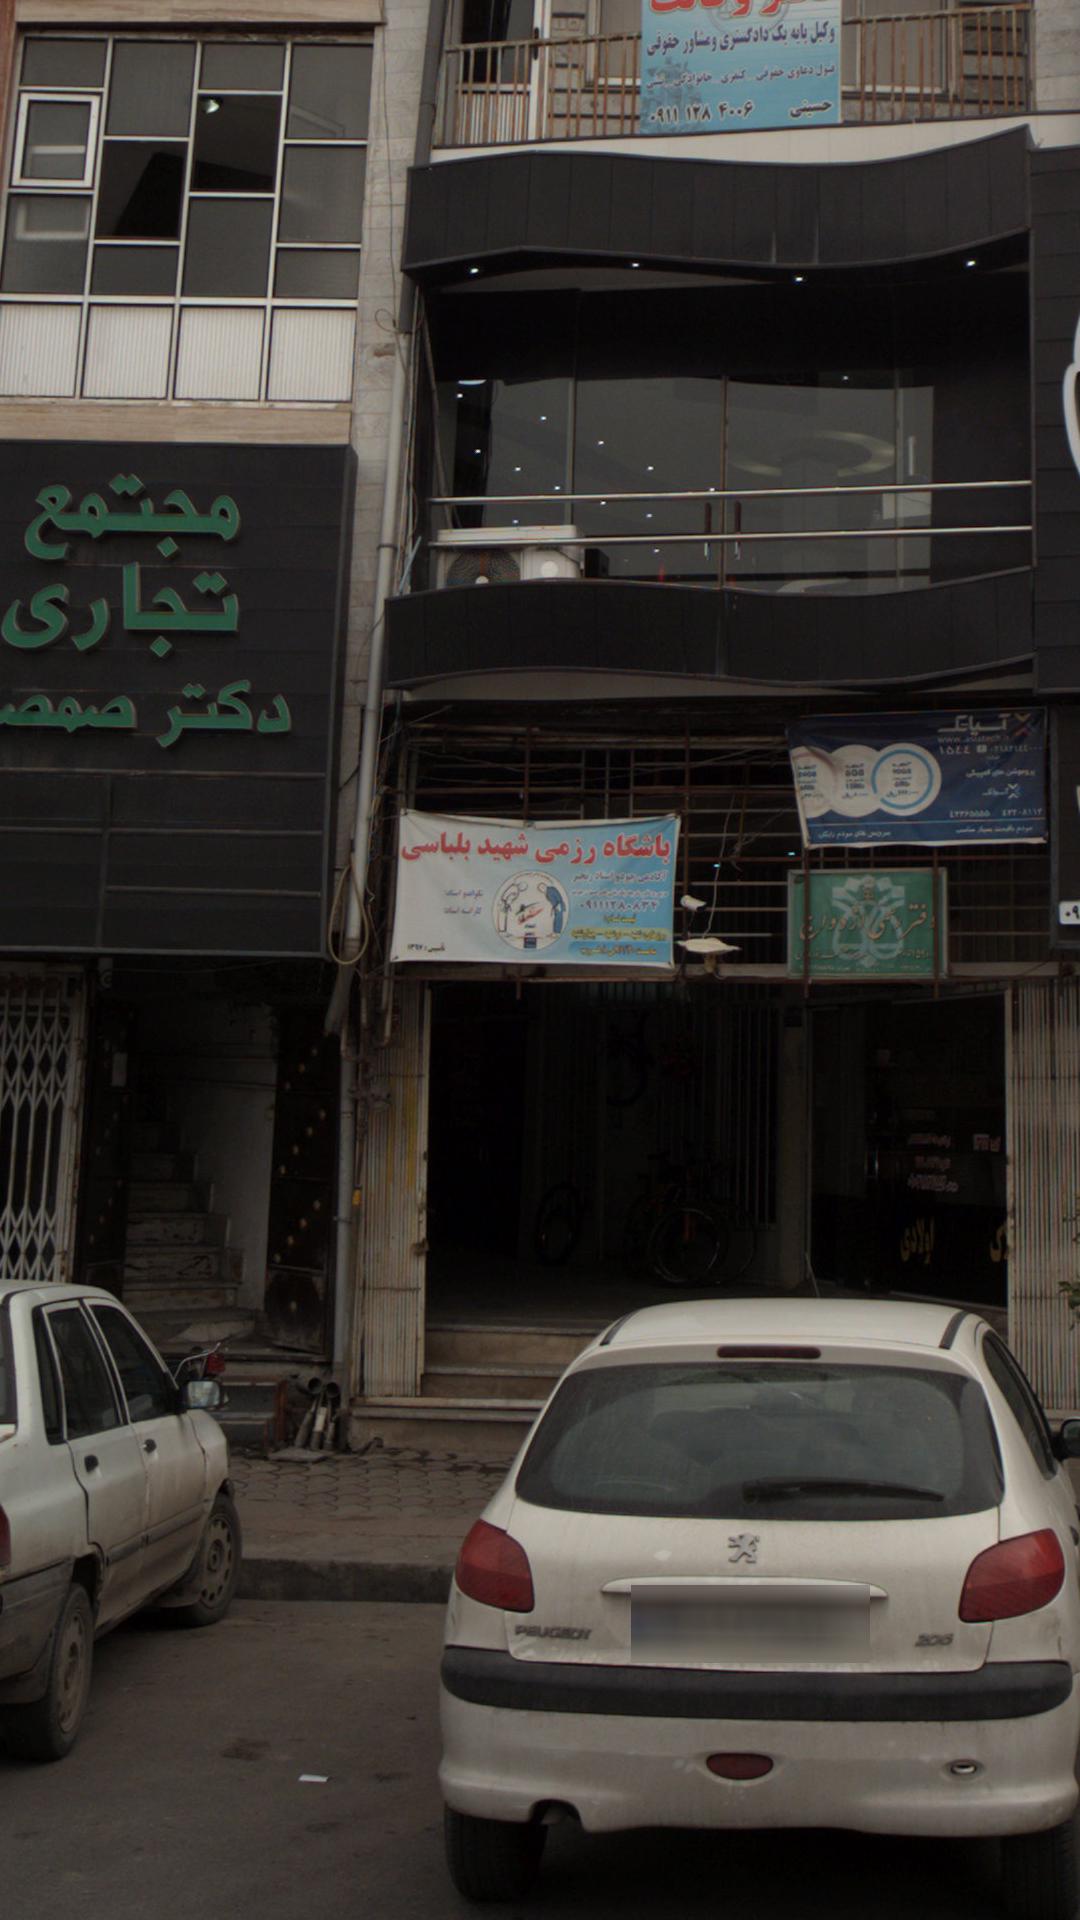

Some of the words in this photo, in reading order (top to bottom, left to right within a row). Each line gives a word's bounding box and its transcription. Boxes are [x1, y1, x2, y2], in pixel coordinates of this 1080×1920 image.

[811, 21, 836, 45] وکیل
[790, 101, 832, 119] حسینی
[25, 473, 240, 560] مجتمع
[1, 561, 239, 658] تجاری
[156, 680, 291, 748] دکتر
[401, 831, 471, 862] بلباسی
[477, 832, 530, 861] شهید
[535, 837, 597, 865] رزمی
[603, 832, 671, 865] باشگاه
[515, 1624, 592, 1641] PEUGEOT
[915, 1632, 954, 1648] 206
